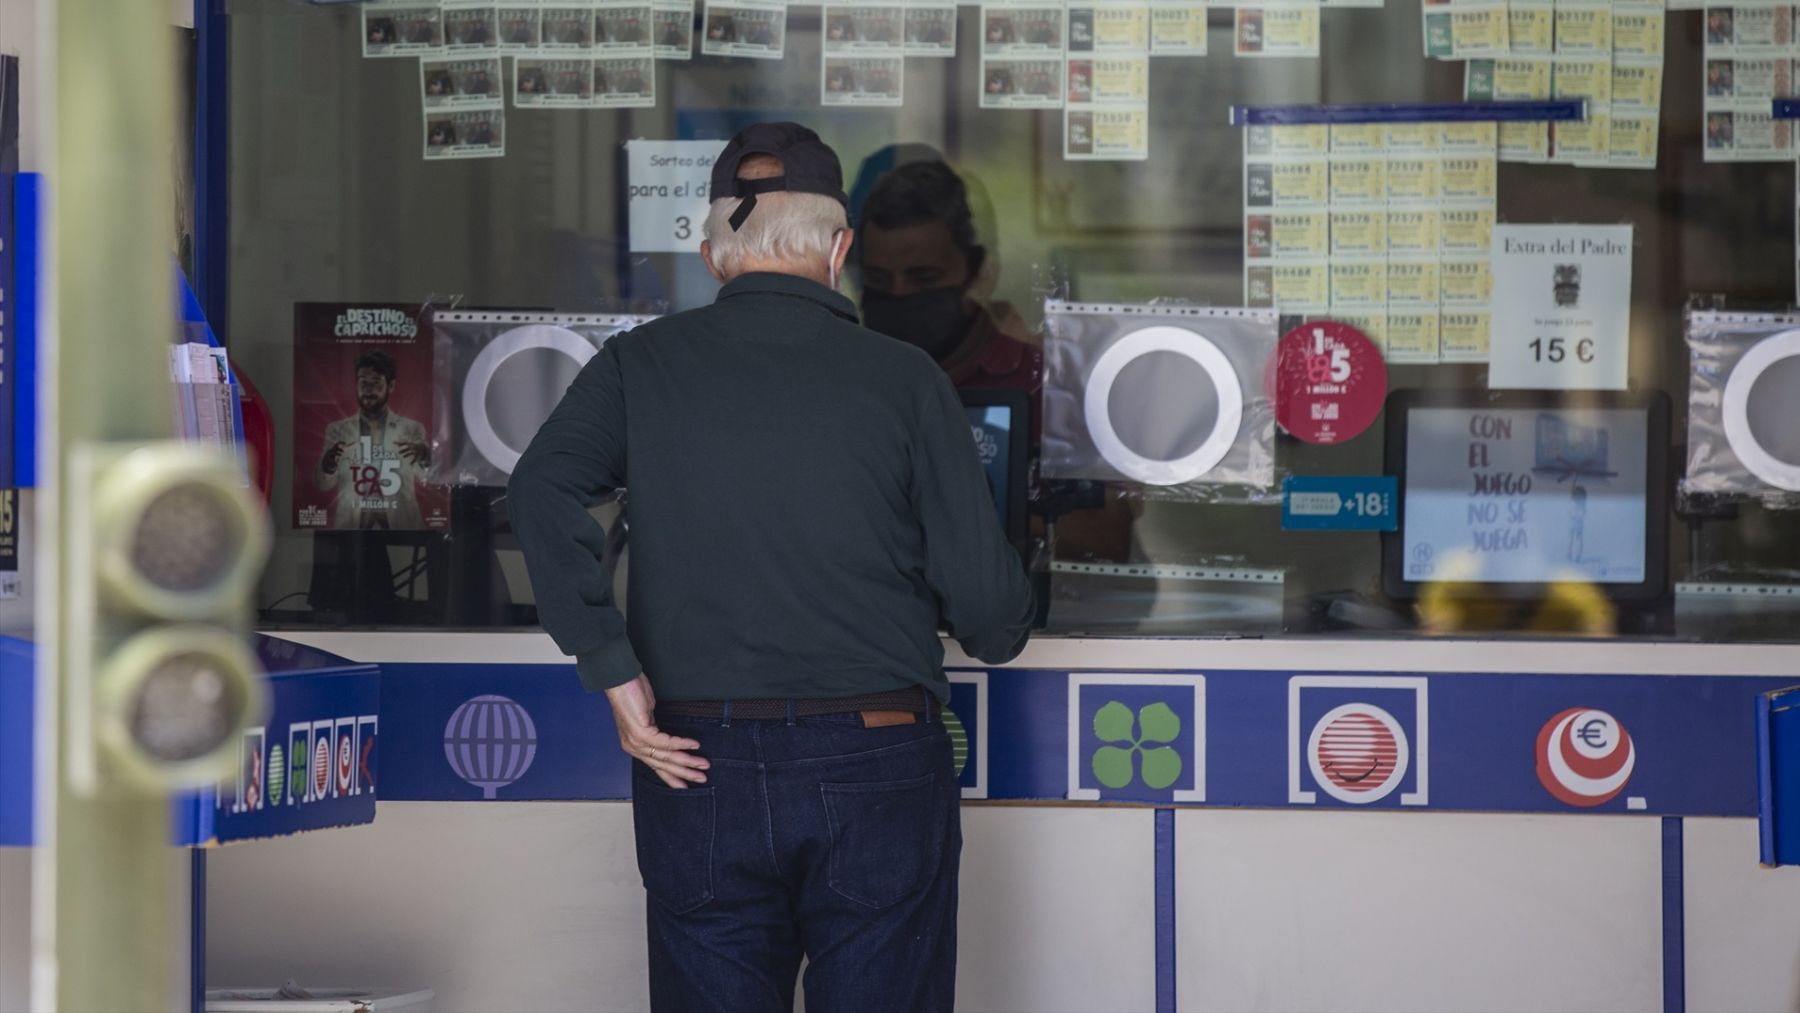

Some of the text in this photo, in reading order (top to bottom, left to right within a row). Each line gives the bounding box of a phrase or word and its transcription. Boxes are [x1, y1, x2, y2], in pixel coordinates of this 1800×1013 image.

[649, 155, 694, 167] Sorteo
[630, 181, 711, 200] para el d
[675, 216, 691, 240] 3
[1504, 238, 1627, 255] Extra del Padre
[347, 308, 405, 324] DESTINO
[335, 322, 417, 338] CAPRICHOSO
[1312, 328, 1324, 355] 1
[1529, 337, 1594, 364] 15 €
[1330, 349, 1351, 382] 5
[1469, 414, 1512, 441] CON
[360, 435, 372, 464] 1
[1467, 443, 1490, 468] EL
[380, 459, 401, 496] 5
[1467, 472, 1532, 498] JUEGO
[1344, 492, 1383, 516] +18
[1467, 499, 1527, 527] NO SE
[1469, 528, 1528, 554] JUEGA
